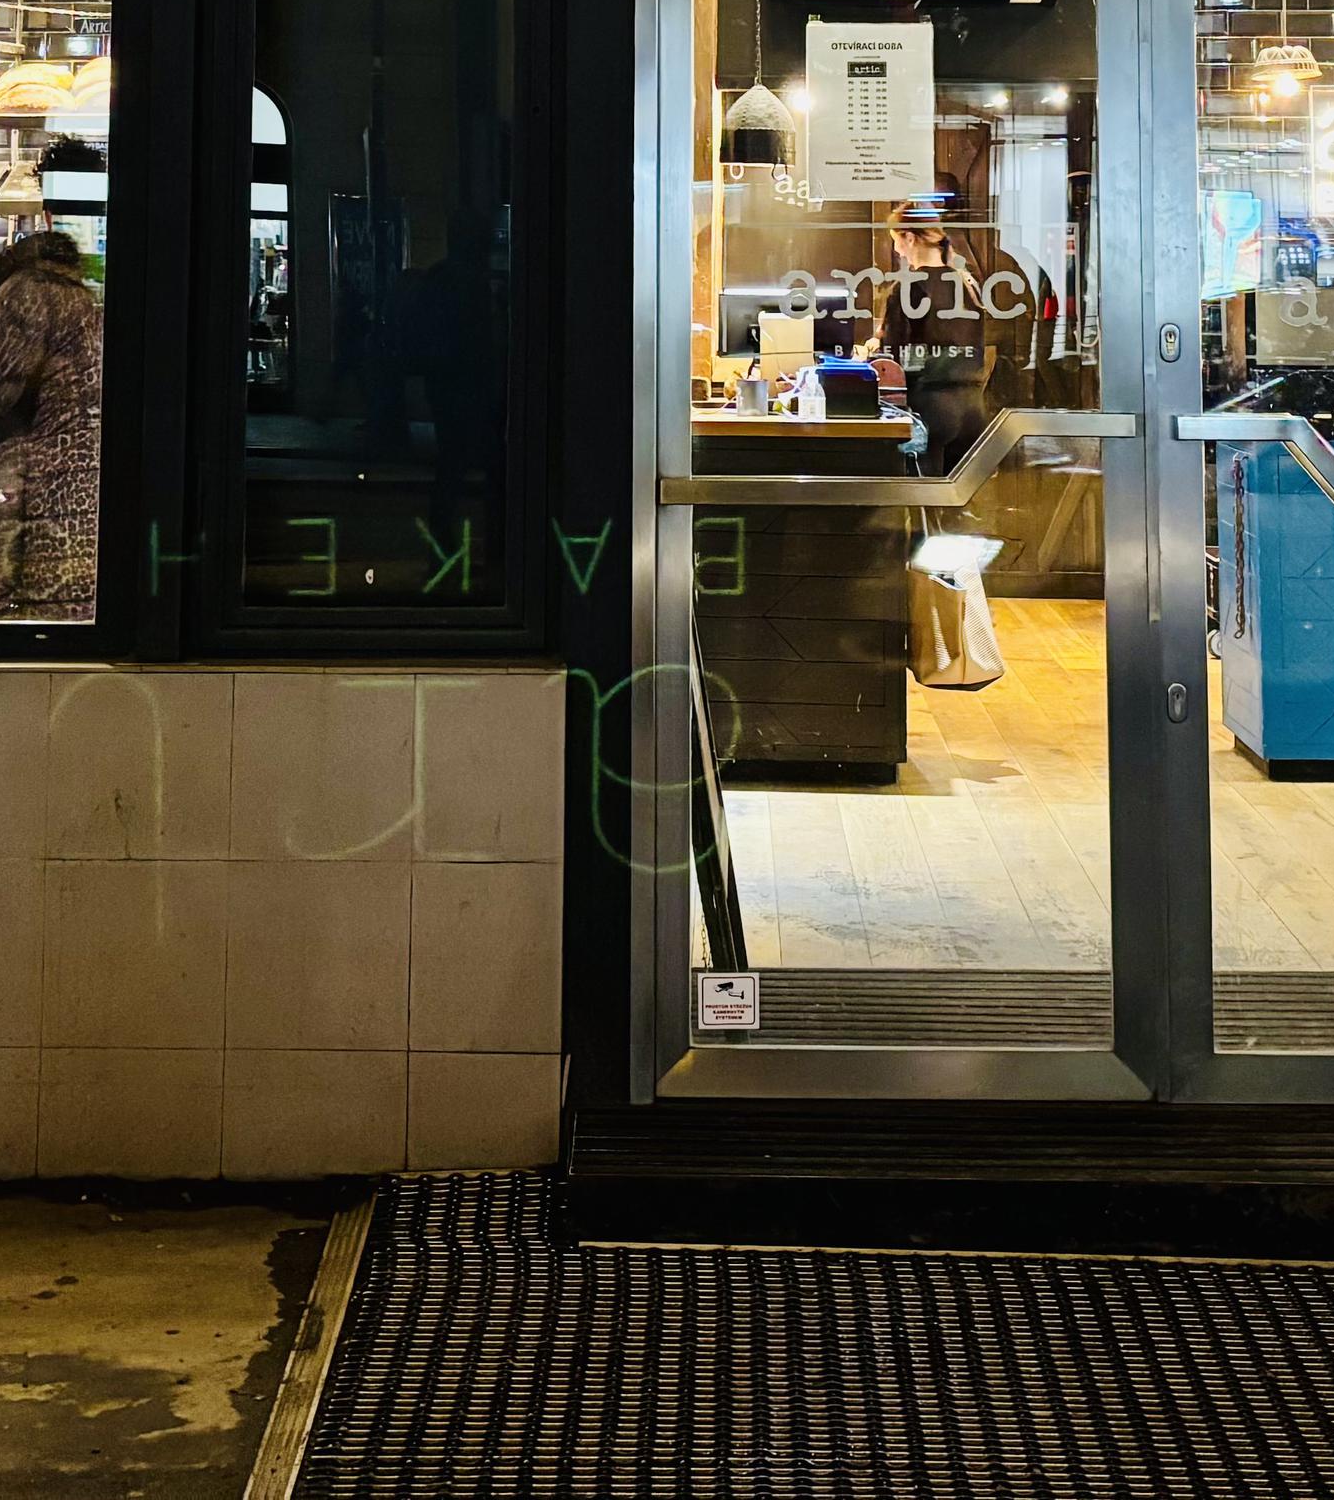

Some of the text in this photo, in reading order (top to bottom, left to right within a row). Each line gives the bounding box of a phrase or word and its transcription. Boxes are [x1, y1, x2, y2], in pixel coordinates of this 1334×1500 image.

[831, 41, 903, 51] OTEVÍRACÍ DOBA
[778, 256, 1028, 320] artic
